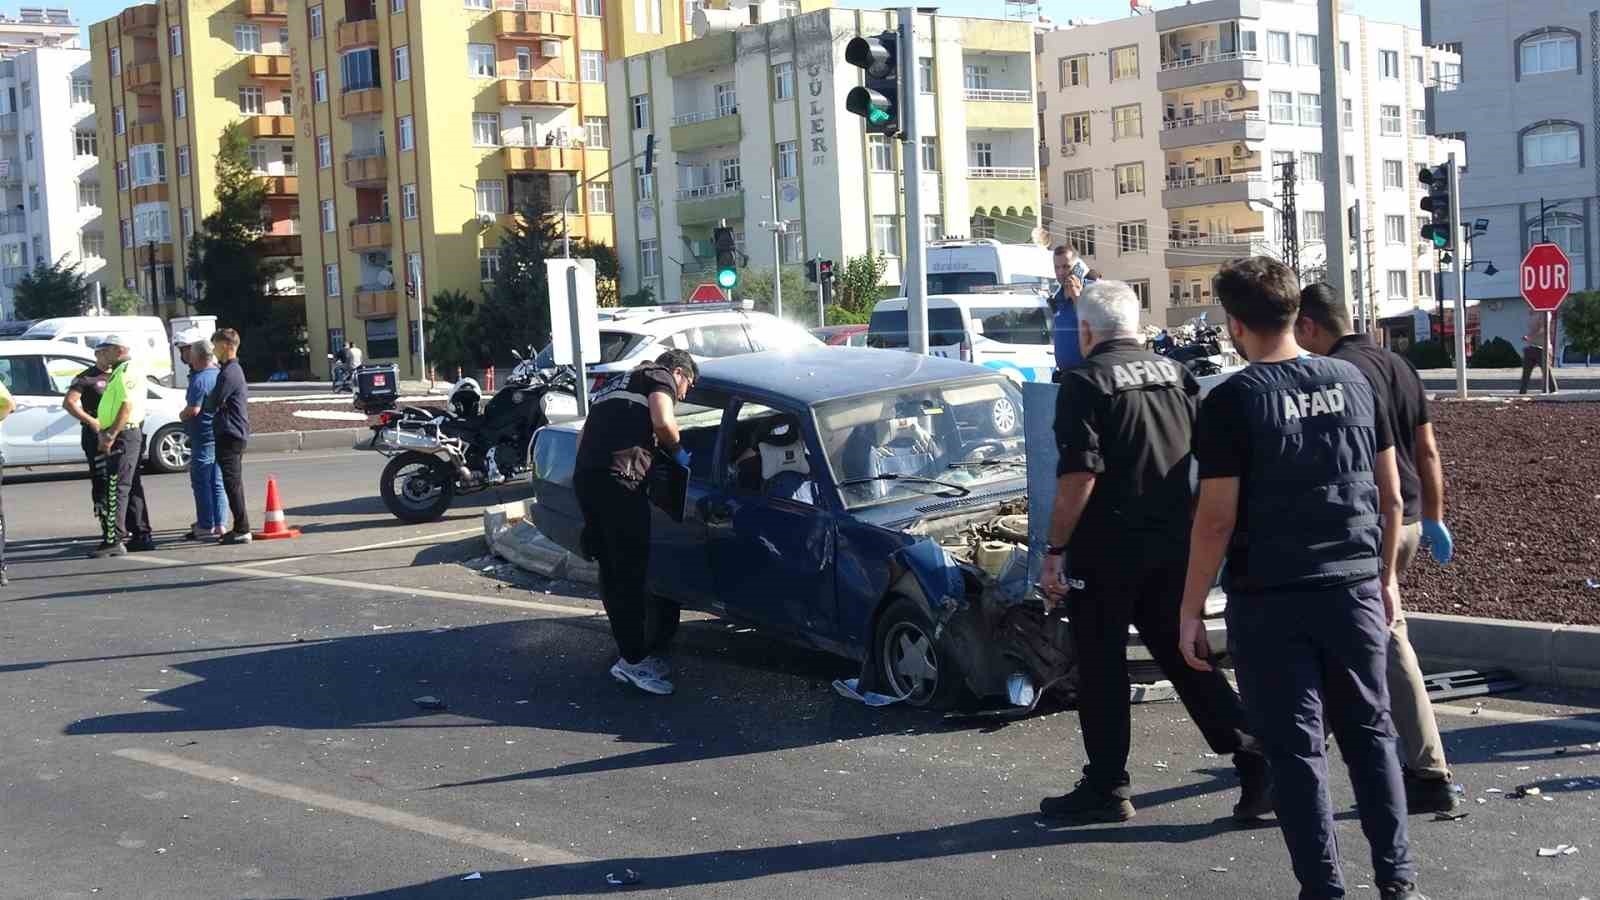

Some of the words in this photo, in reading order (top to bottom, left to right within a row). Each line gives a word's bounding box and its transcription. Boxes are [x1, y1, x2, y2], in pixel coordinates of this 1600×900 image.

[1524, 264, 1566, 291] DUR
[1112, 360, 1177, 388] AFAD
[1284, 387, 1345, 420] AFAD
